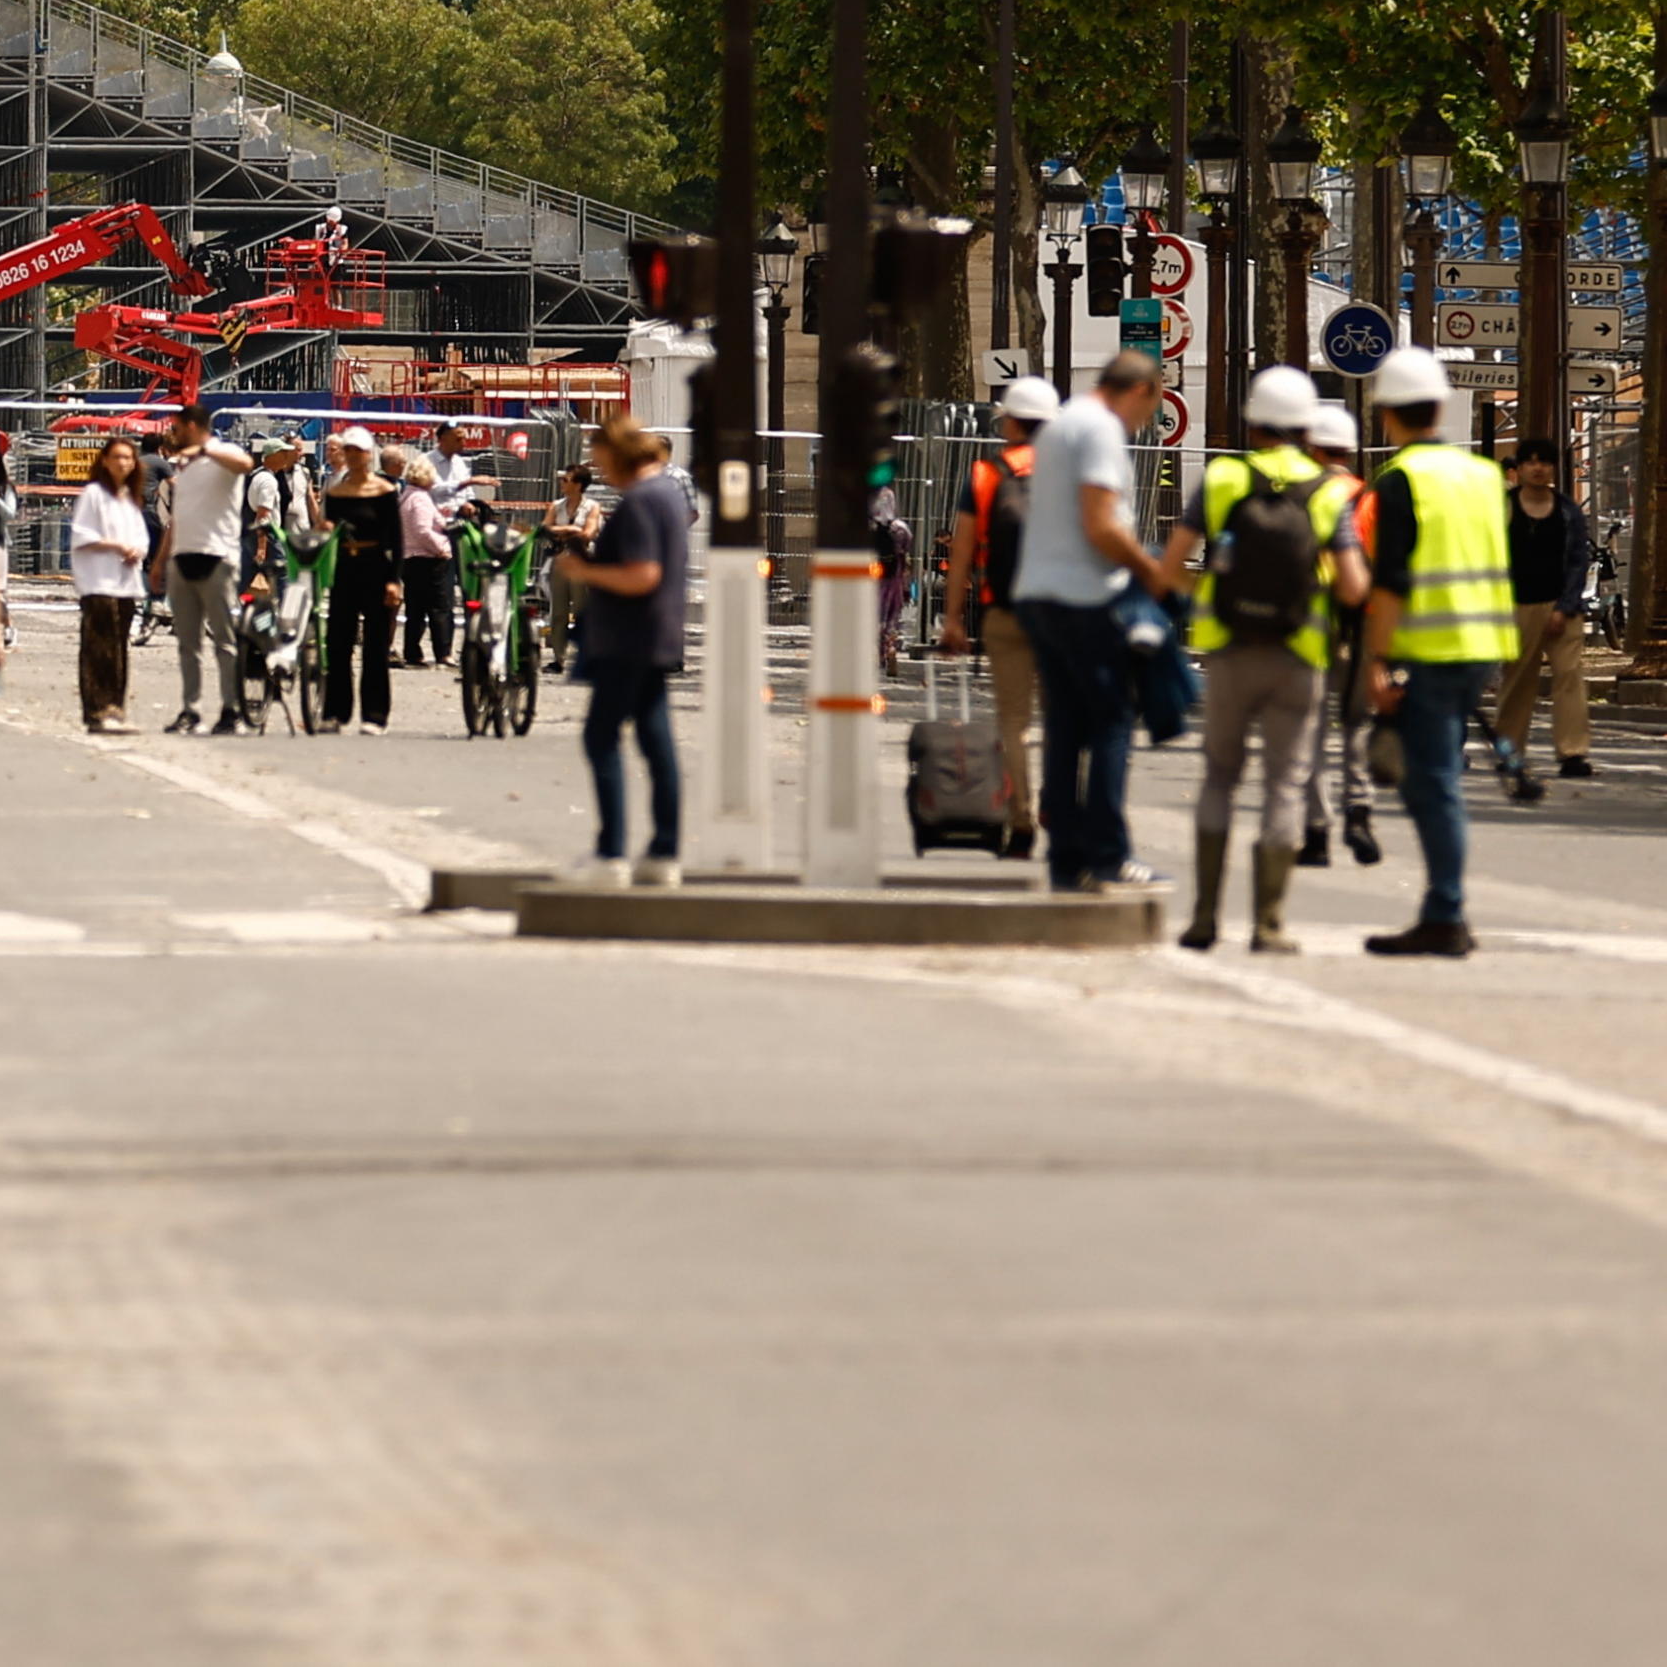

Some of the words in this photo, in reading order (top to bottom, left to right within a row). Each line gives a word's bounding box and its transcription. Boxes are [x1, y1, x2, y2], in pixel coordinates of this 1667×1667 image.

[31, 254, 50, 273] 16
[50, 239, 86, 265] 1234
[1447, 369, 1515, 384] uileries
[61, 437, 108, 448] ATTENTIO
